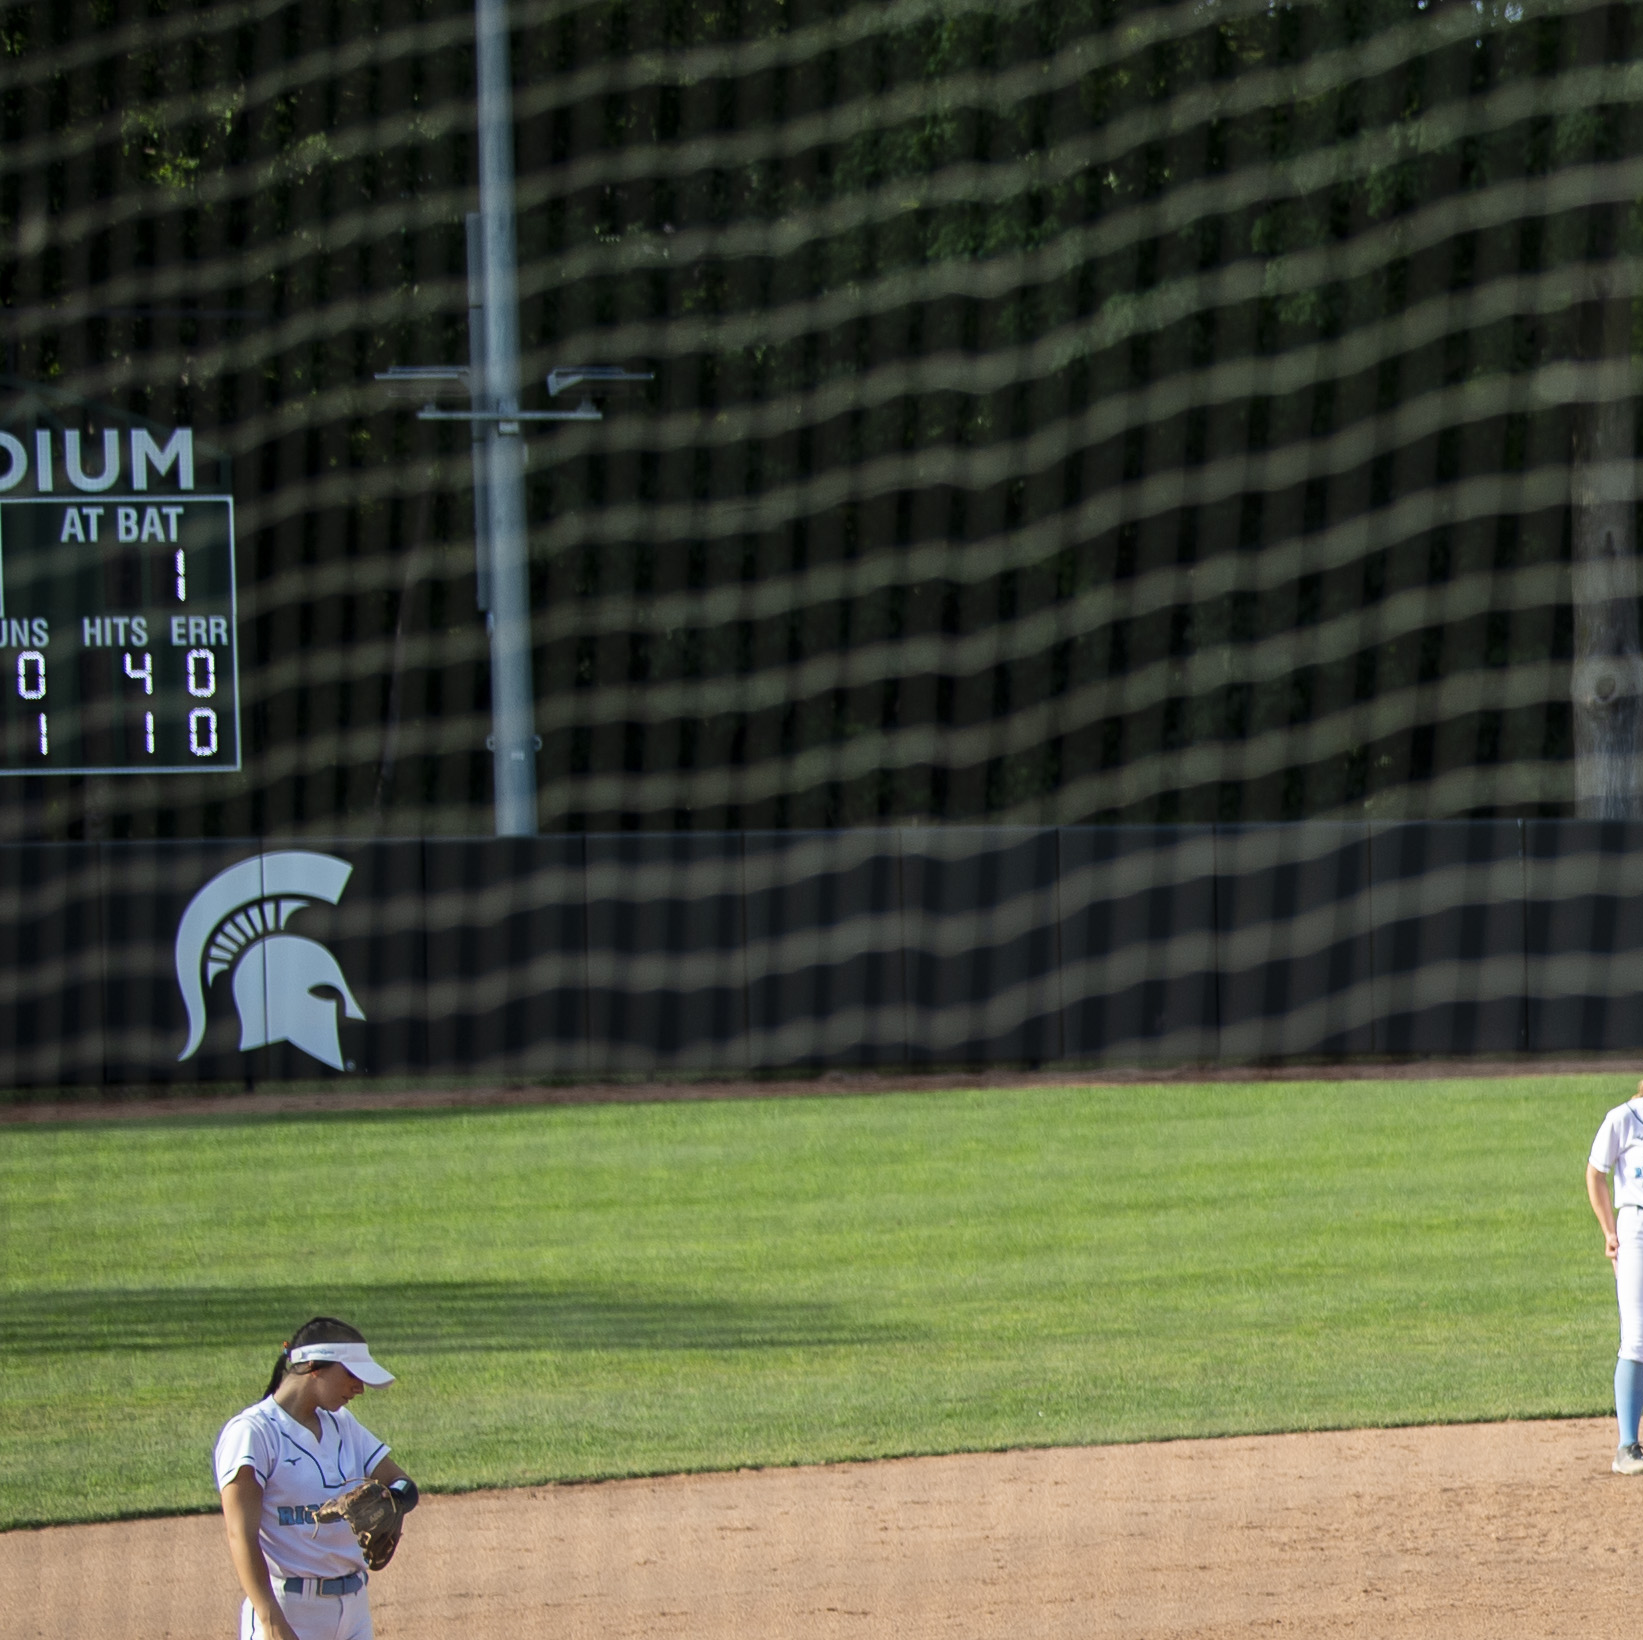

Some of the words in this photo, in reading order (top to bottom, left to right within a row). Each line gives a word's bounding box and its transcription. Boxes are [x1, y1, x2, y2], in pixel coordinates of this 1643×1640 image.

[60, 506, 104, 542] AT
[117, 506, 184, 543] BAT
[176, 548, 186, 601] 1
[83, 615, 148, 647] HITS
[171, 615, 228, 646] ERR
[17, 650, 46, 699] 0
[124, 652, 152, 695] 4
[187, 648, 216, 698] 0
[39, 712, 48, 755] 1
[145, 711, 155, 754] 1
[188, 706, 217, 756] 0
